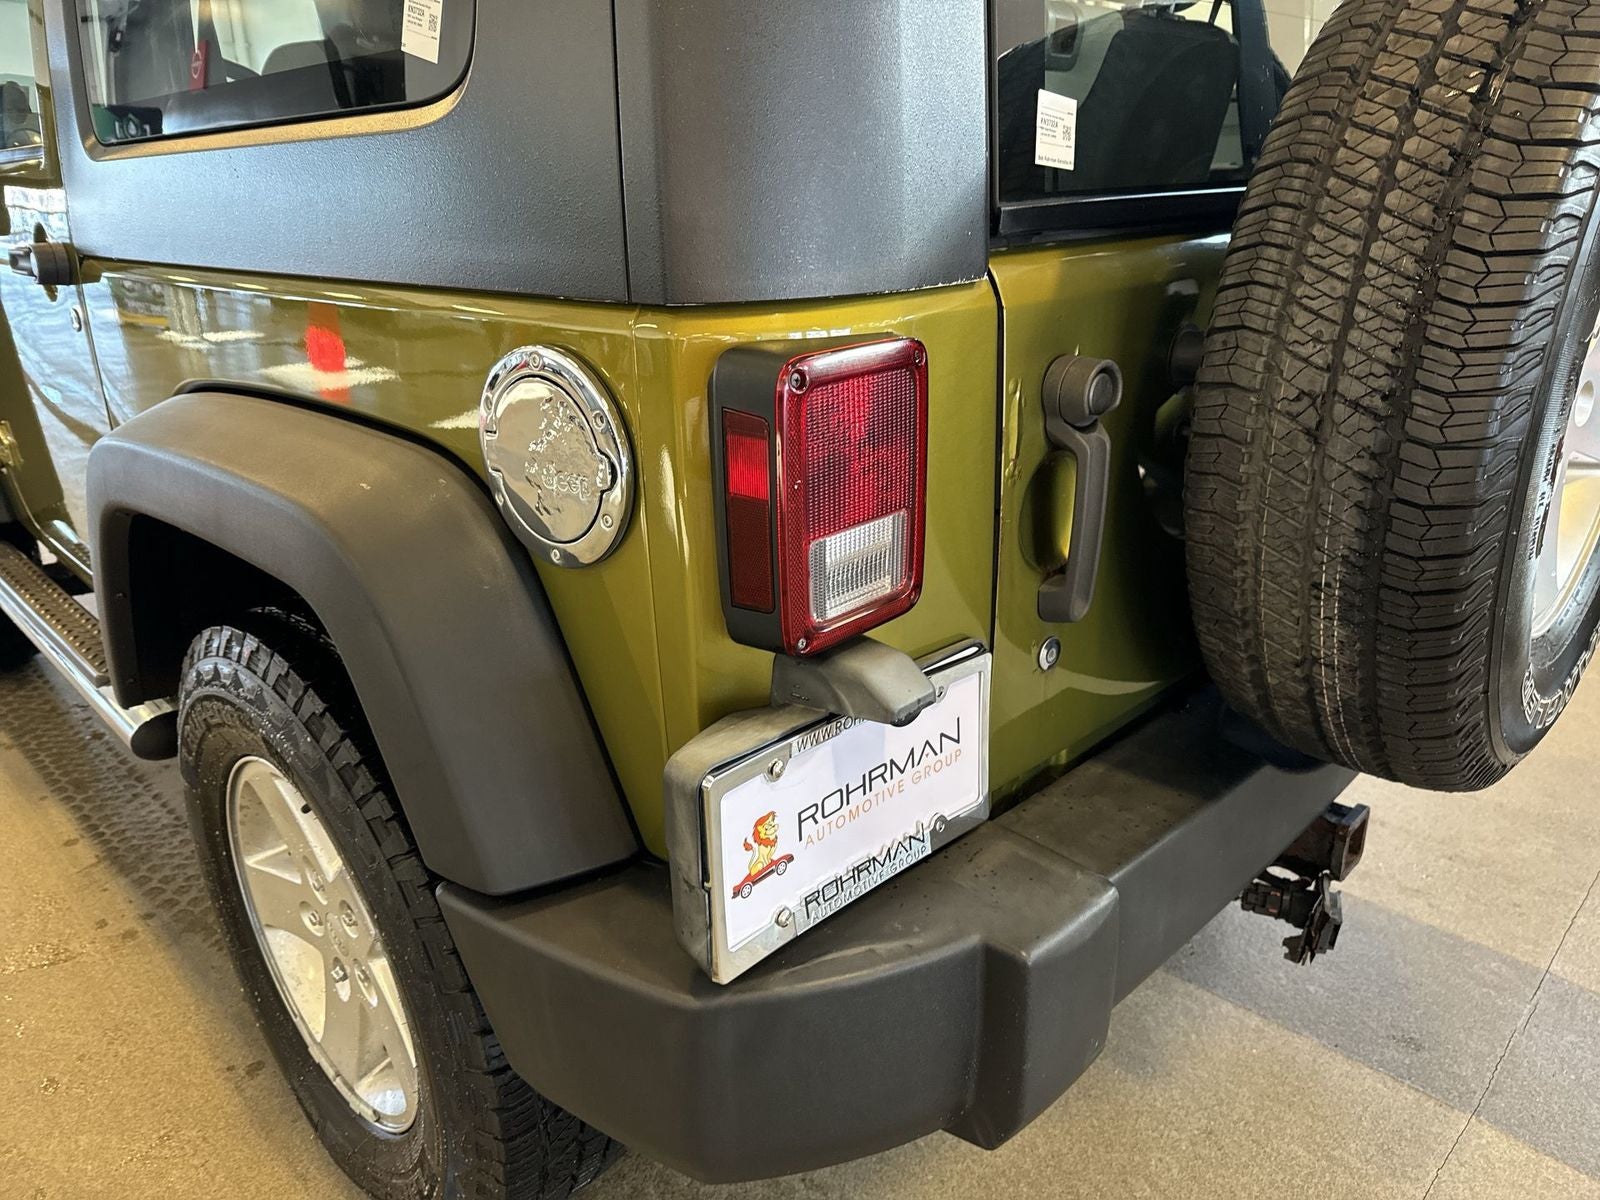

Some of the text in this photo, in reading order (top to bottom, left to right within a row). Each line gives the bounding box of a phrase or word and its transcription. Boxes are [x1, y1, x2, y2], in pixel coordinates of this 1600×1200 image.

[797, 716, 961, 843] ROHRMAN
[805, 748, 963, 850] AUTOMOTIVE GROUP
[804, 822, 926, 919] ROHRMAN
[809, 845, 928, 924] AUTOMOTIVE GROUP
